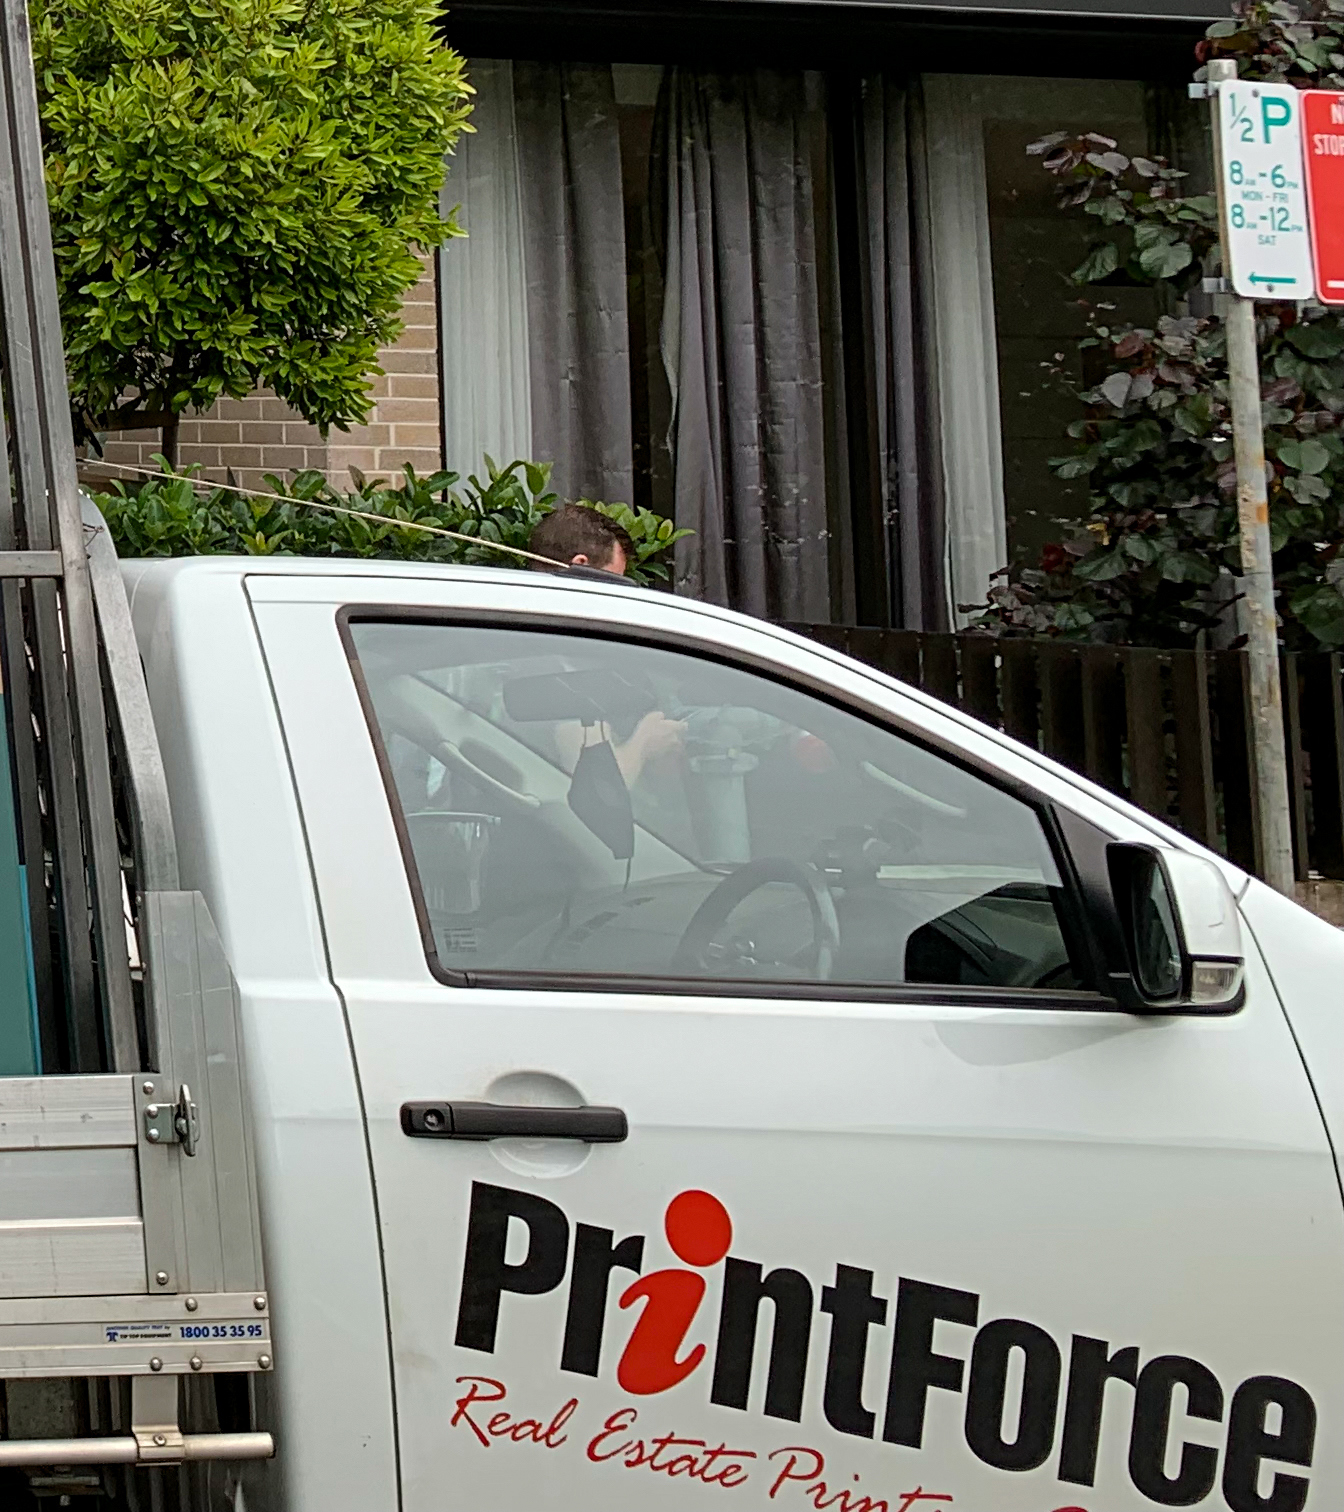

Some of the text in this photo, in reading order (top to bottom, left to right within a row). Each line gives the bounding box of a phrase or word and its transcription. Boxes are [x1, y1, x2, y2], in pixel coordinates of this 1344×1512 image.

[1331, 103, 1344, 125] N
[1257, 234, 1277, 246] SAT
[180, 1324, 262, 1338] 1800 35 35 95
[454, 1179, 1318, 1512] PrintForce
[449, 1376, 954, 1512] Real Estate Print
